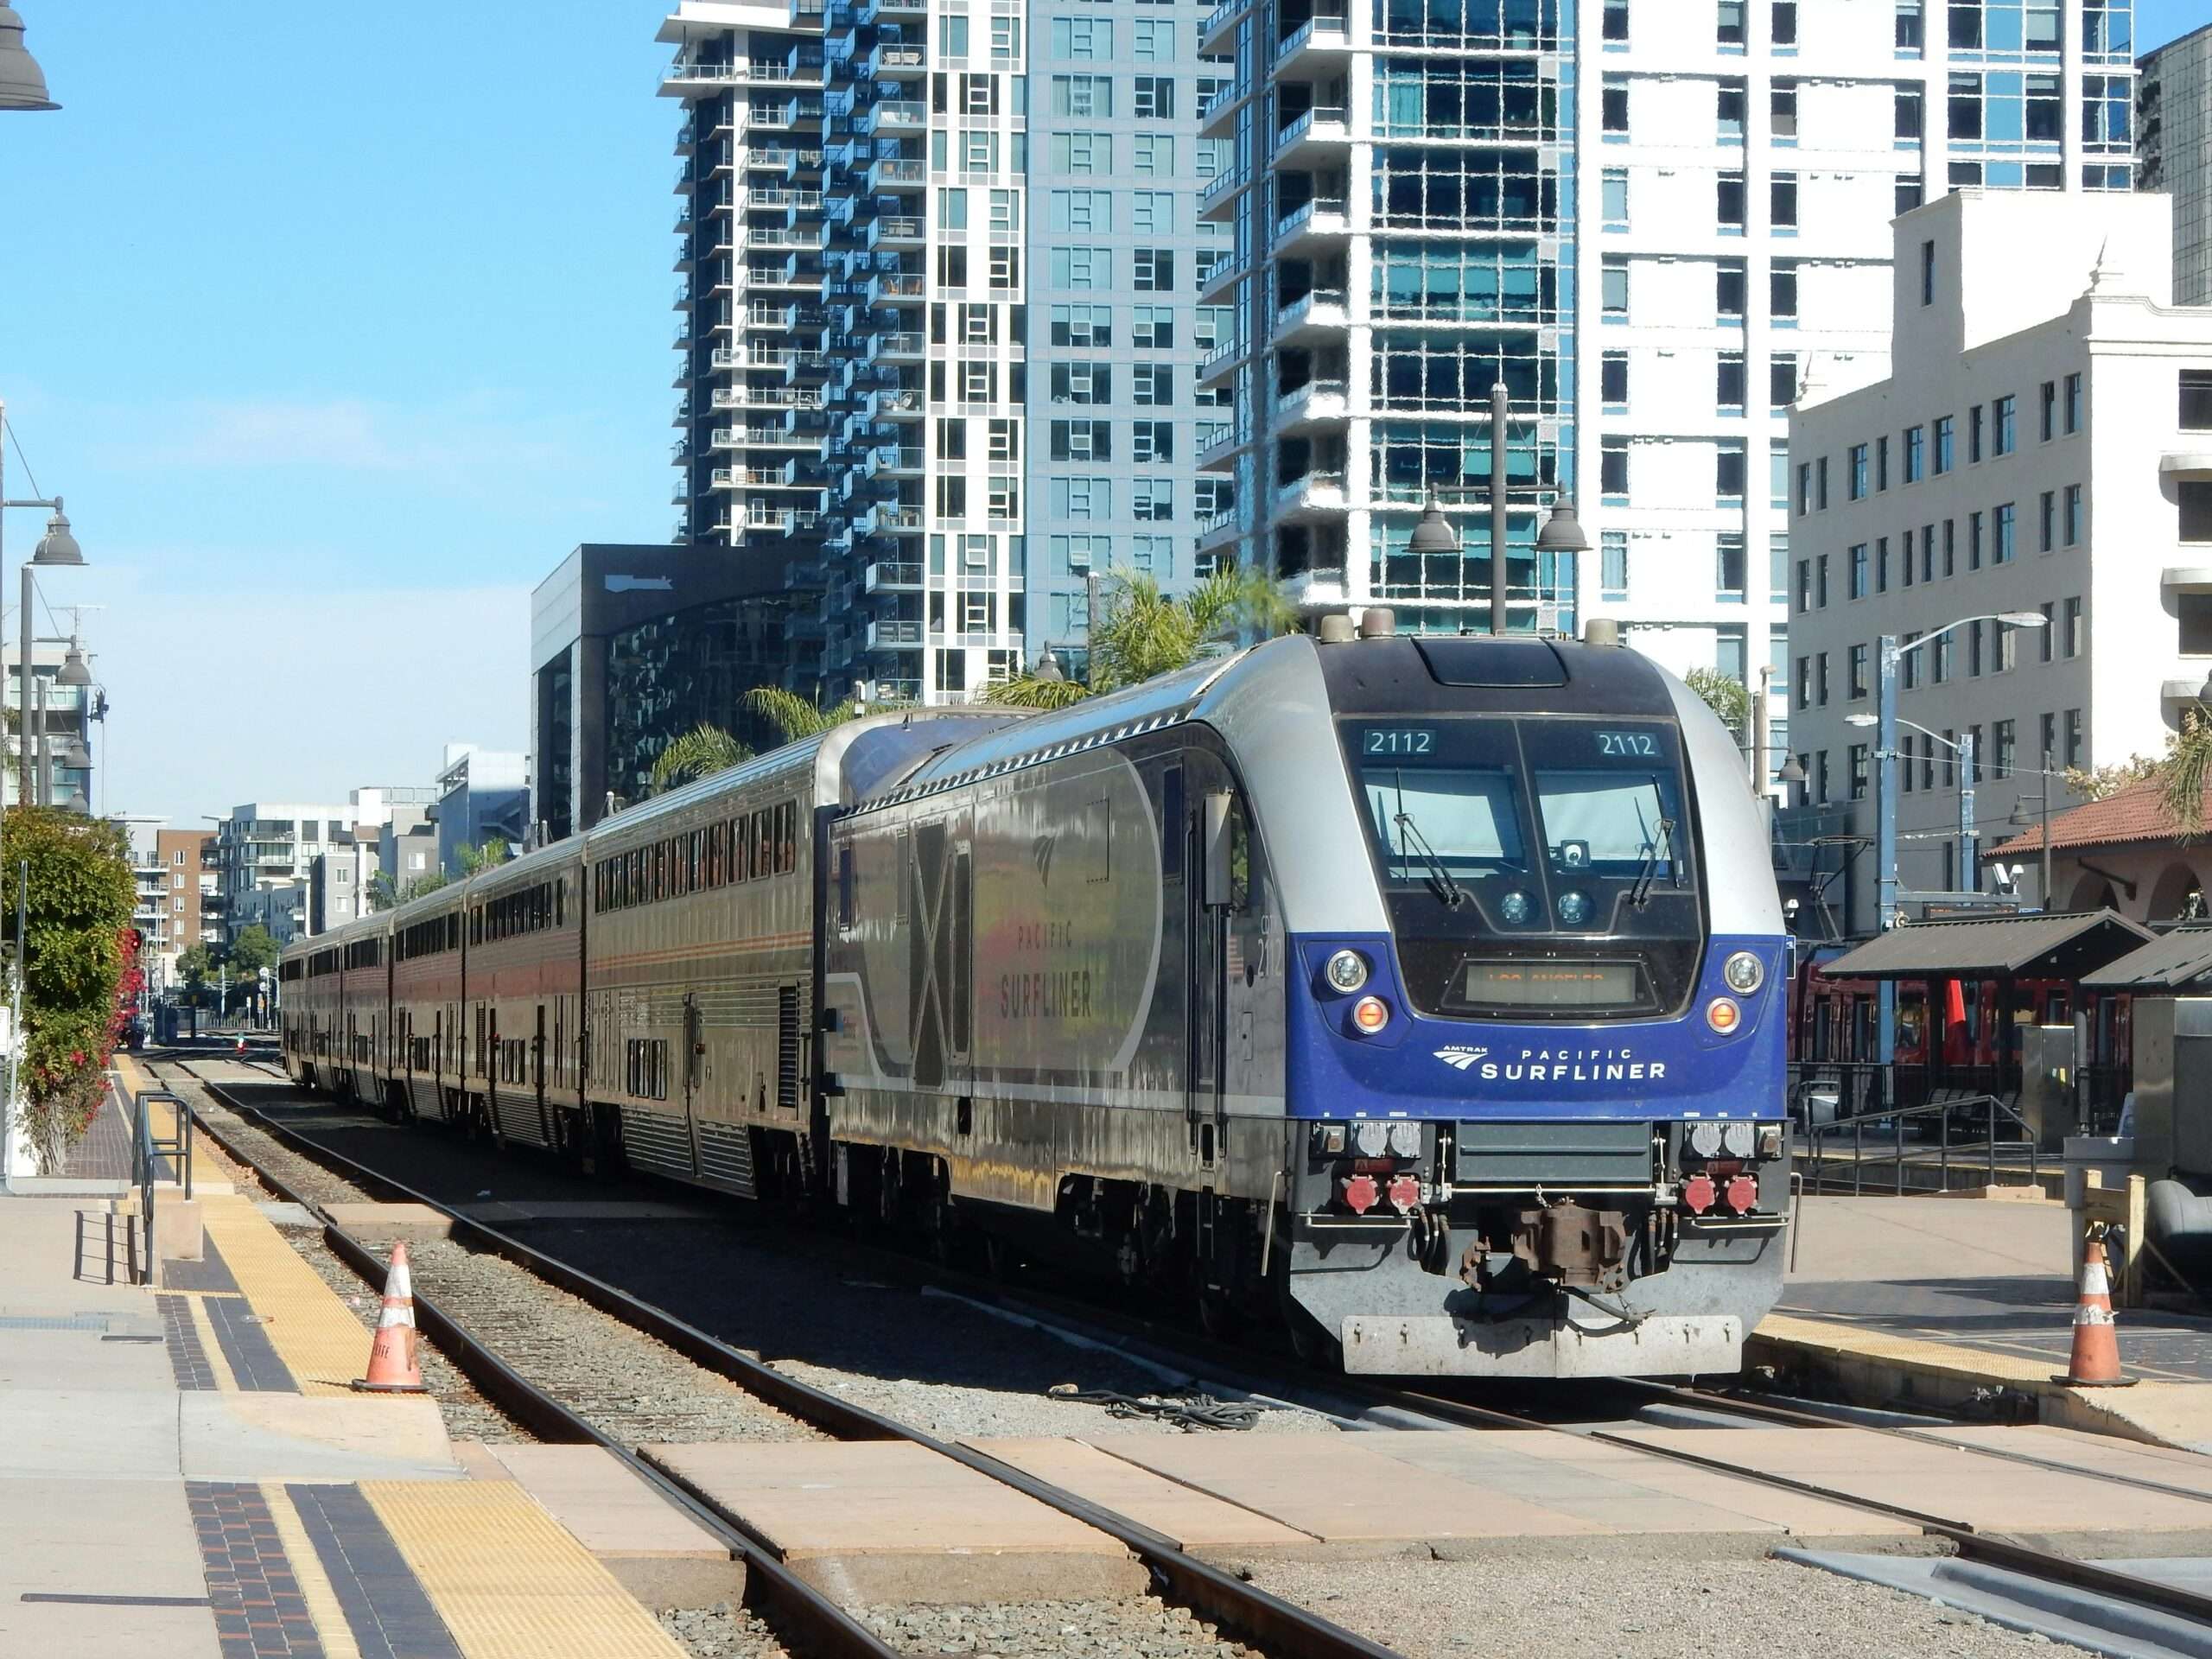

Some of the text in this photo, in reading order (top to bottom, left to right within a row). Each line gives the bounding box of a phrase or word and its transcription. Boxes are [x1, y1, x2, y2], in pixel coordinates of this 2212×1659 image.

[1370, 732, 1430, 752] 2112
[1599, 734, 1656, 754] 2112
[1017, 920, 1072, 950] PACIFIC
[1257, 938, 1281, 977] 2112
[1001, 970, 1091, 1019] SURFLINER
[1443, 1045, 1488, 1053] AMTRAK
[1522, 1049, 1631, 1060] PACIFIC
[1480, 1062, 1666, 1080] SURFLINER
